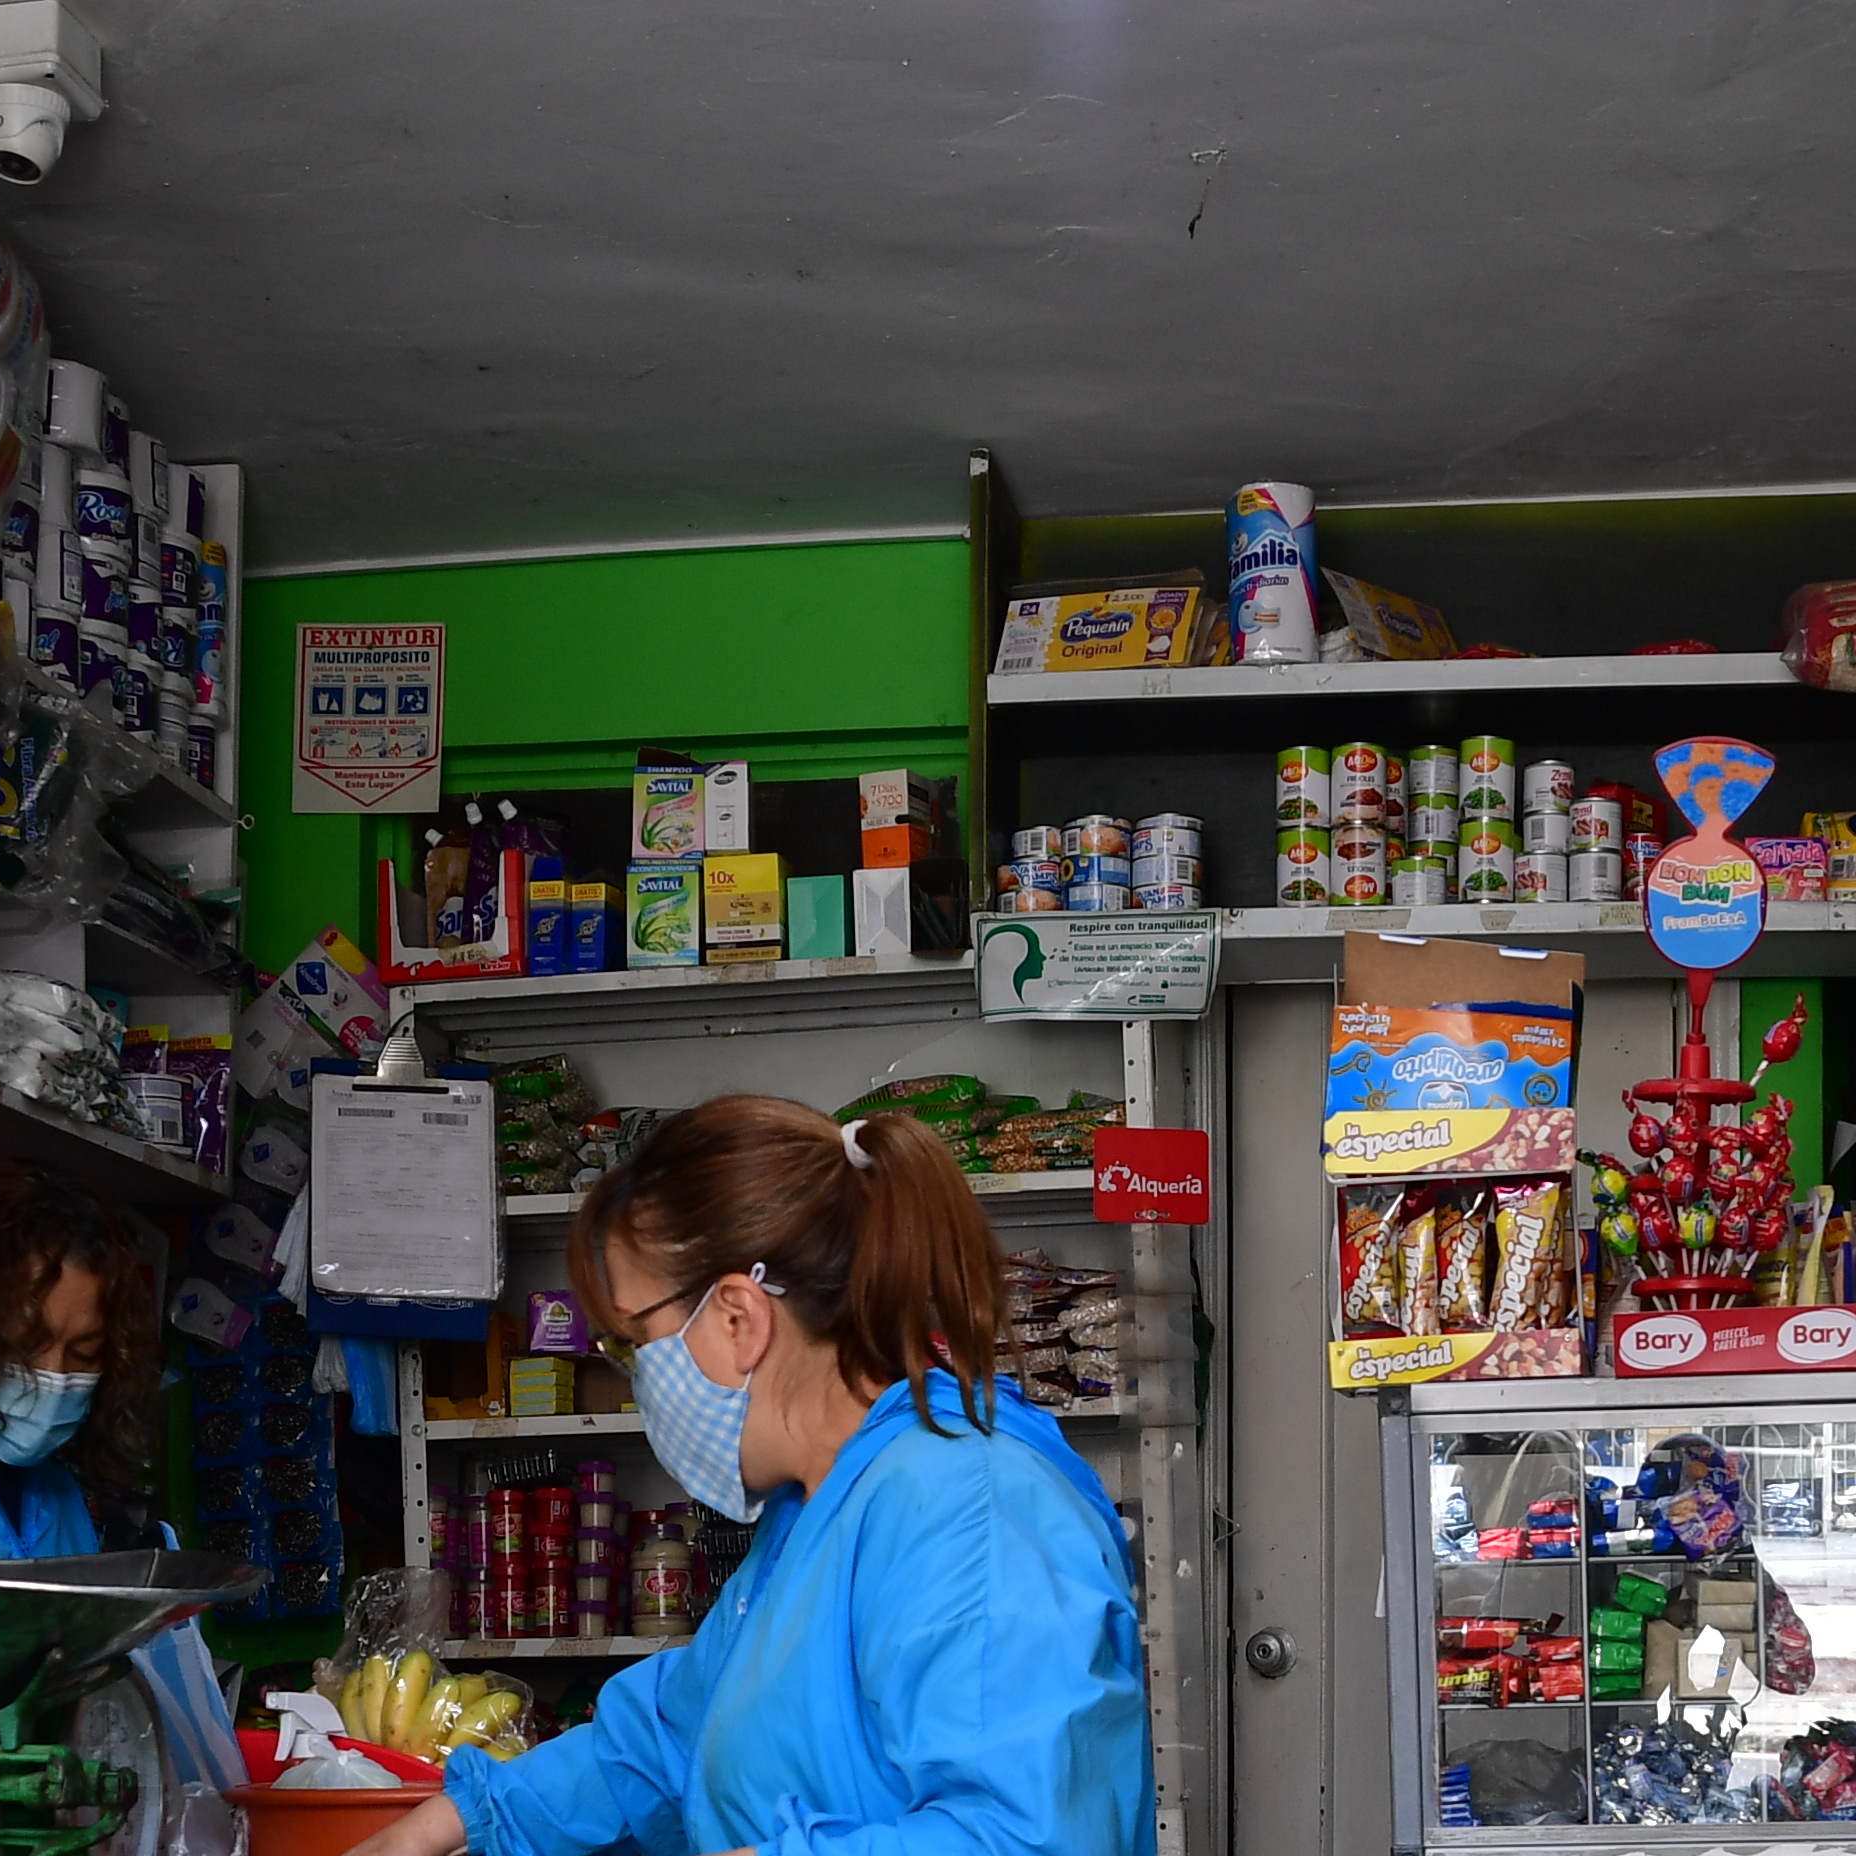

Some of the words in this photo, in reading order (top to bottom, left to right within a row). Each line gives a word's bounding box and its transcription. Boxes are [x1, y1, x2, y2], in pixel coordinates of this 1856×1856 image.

[1019, 603, 1038, 615] 24
[1064, 616, 1132, 638] Pequeñín
[310, 629, 435, 645] EXTINTOR
[314, 651, 430, 664] MULTIPROPOSITO
[1062, 642, 1122, 659] Original
[335, 771, 380, 781] Mantenga
[382, 771, 405, 779] Libre
[646, 766, 693, 774] SHAMPOO
[345, 780, 365, 788] Este
[369, 780, 394, 789] Lugar
[647, 779, 693, 793] SAVITAL
[638, 877, 683, 891] SAVITAL
[708, 870, 735, 885] 10x
[1682, 884, 1731, 904] BUM
[1069, 923, 1111, 934] Respire
[1114, 922, 1135, 930] con
[1138, 919, 1208, 932] tranquilidad
[1346, 1123, 1360, 1136] la
[1335, 1119, 1451, 1160] especial
[1126, 1174, 1204, 1198] Alquería
[1713, 1326, 1750, 1341] MERECES
[1793, 1323, 1852, 1347] Bary
[1635, 1331, 1693, 1354] Bary
[1713, 1338, 1738, 1352] DARTE
[1740, 1334, 1766, 1350] GUSTO
[1350, 1341, 1454, 1381] especial
[1357, 1347, 1371, 1360] la
